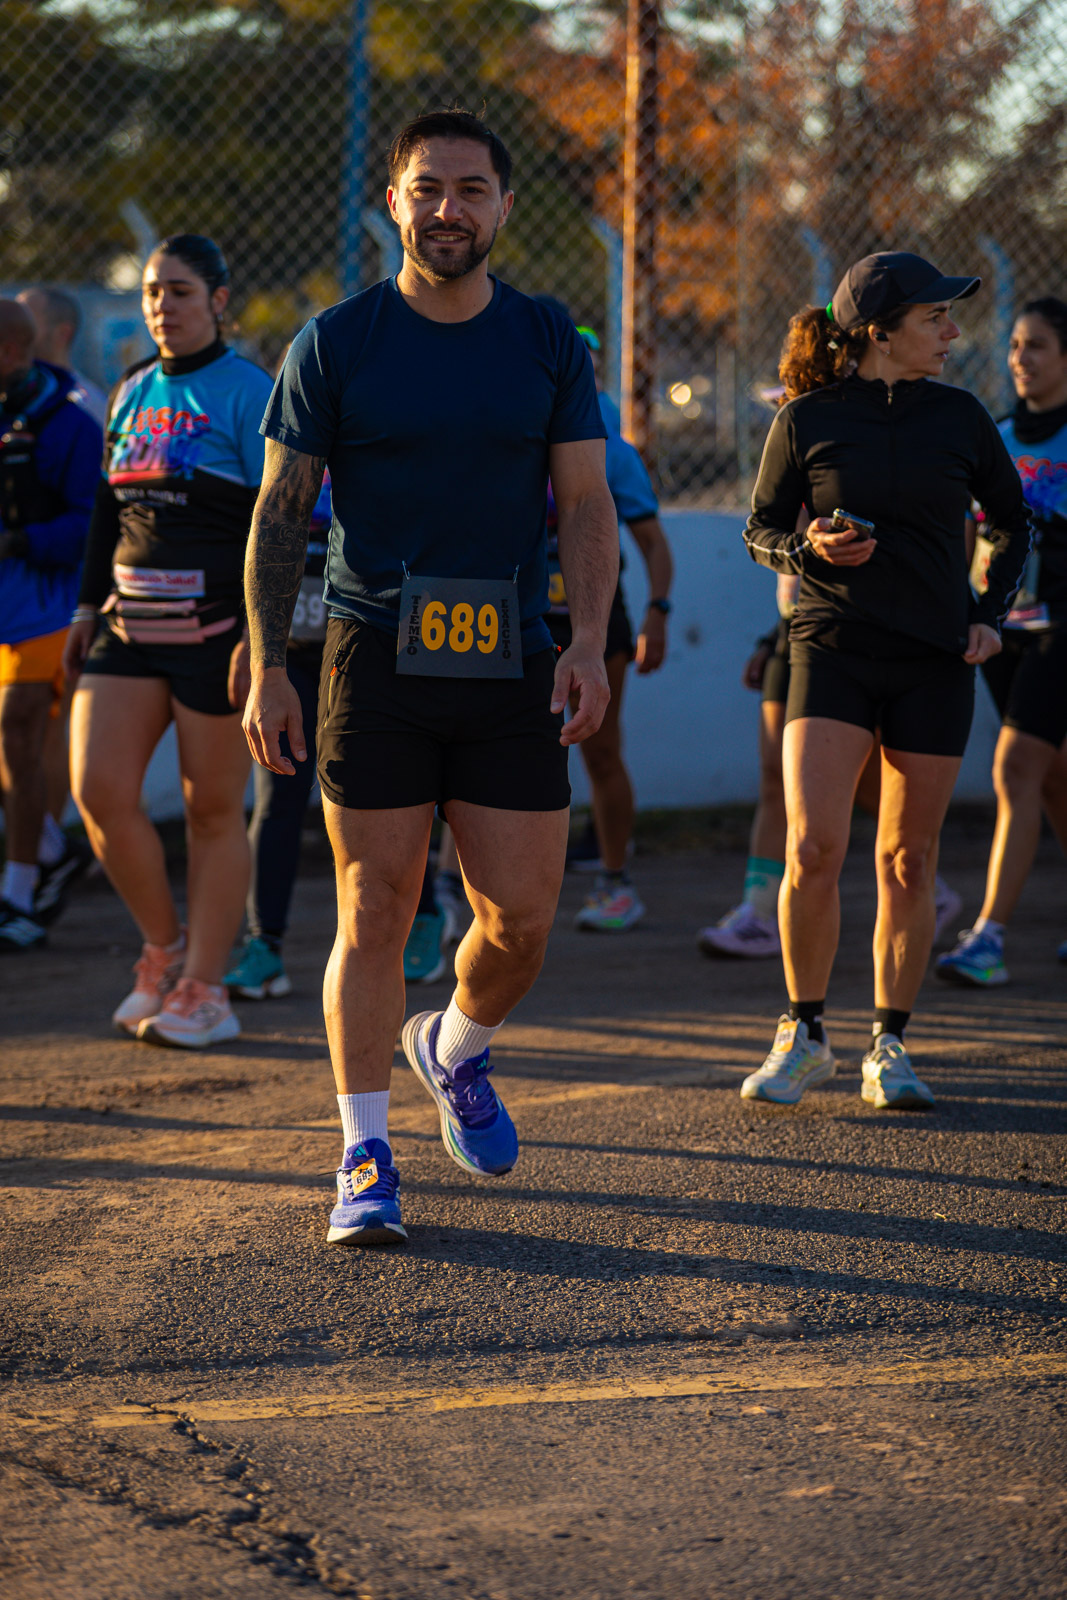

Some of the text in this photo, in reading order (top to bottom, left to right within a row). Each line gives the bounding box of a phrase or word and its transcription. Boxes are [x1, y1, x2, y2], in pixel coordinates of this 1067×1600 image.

[407, 595, 422, 655] TIEMPO
[421, 600, 499, 654] 689
[501, 599, 512, 659] EXACTO
